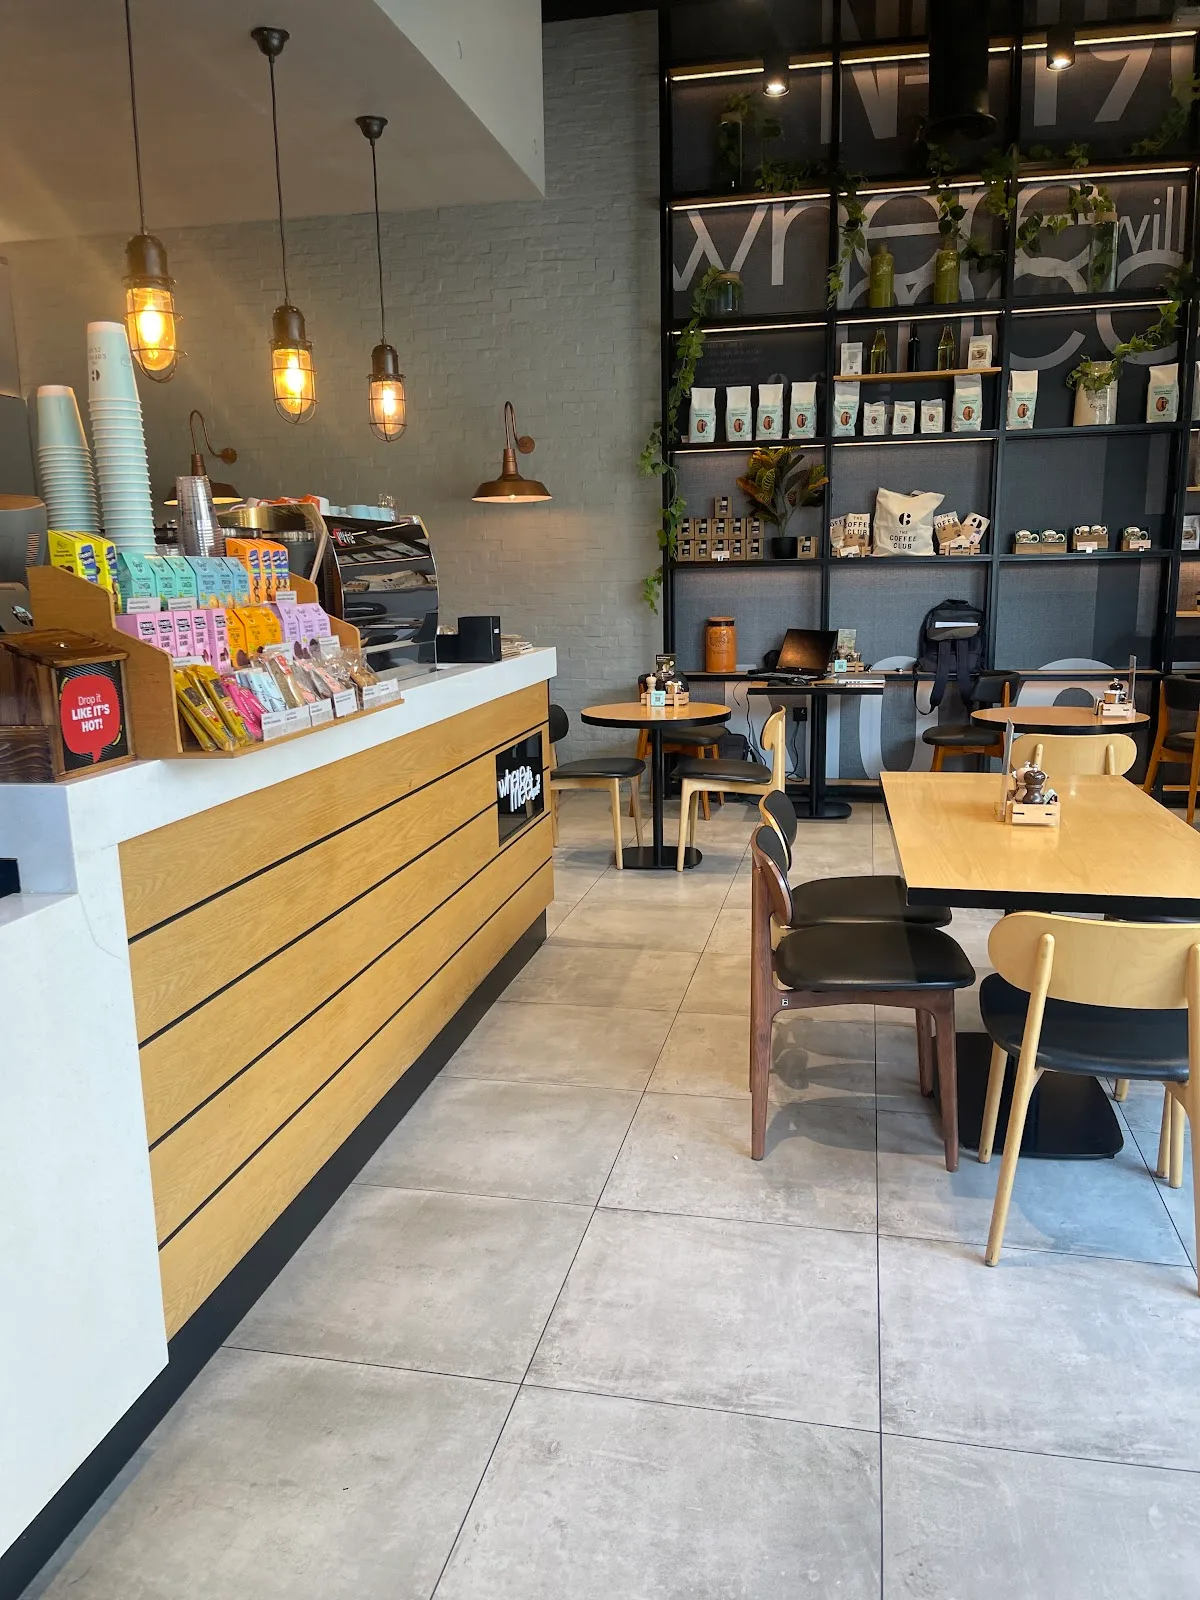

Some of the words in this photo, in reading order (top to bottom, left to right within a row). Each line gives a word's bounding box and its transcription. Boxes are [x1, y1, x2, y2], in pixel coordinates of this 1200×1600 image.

[889, 534, 917, 542] COFFEE
[893, 542, 912, 550] CLUB
[77, 695, 95, 705] Drop
[71, 707, 93, 720] LIKE
[93, 704, 110, 716] IT'S
[82, 718, 103, 732] HOT!
